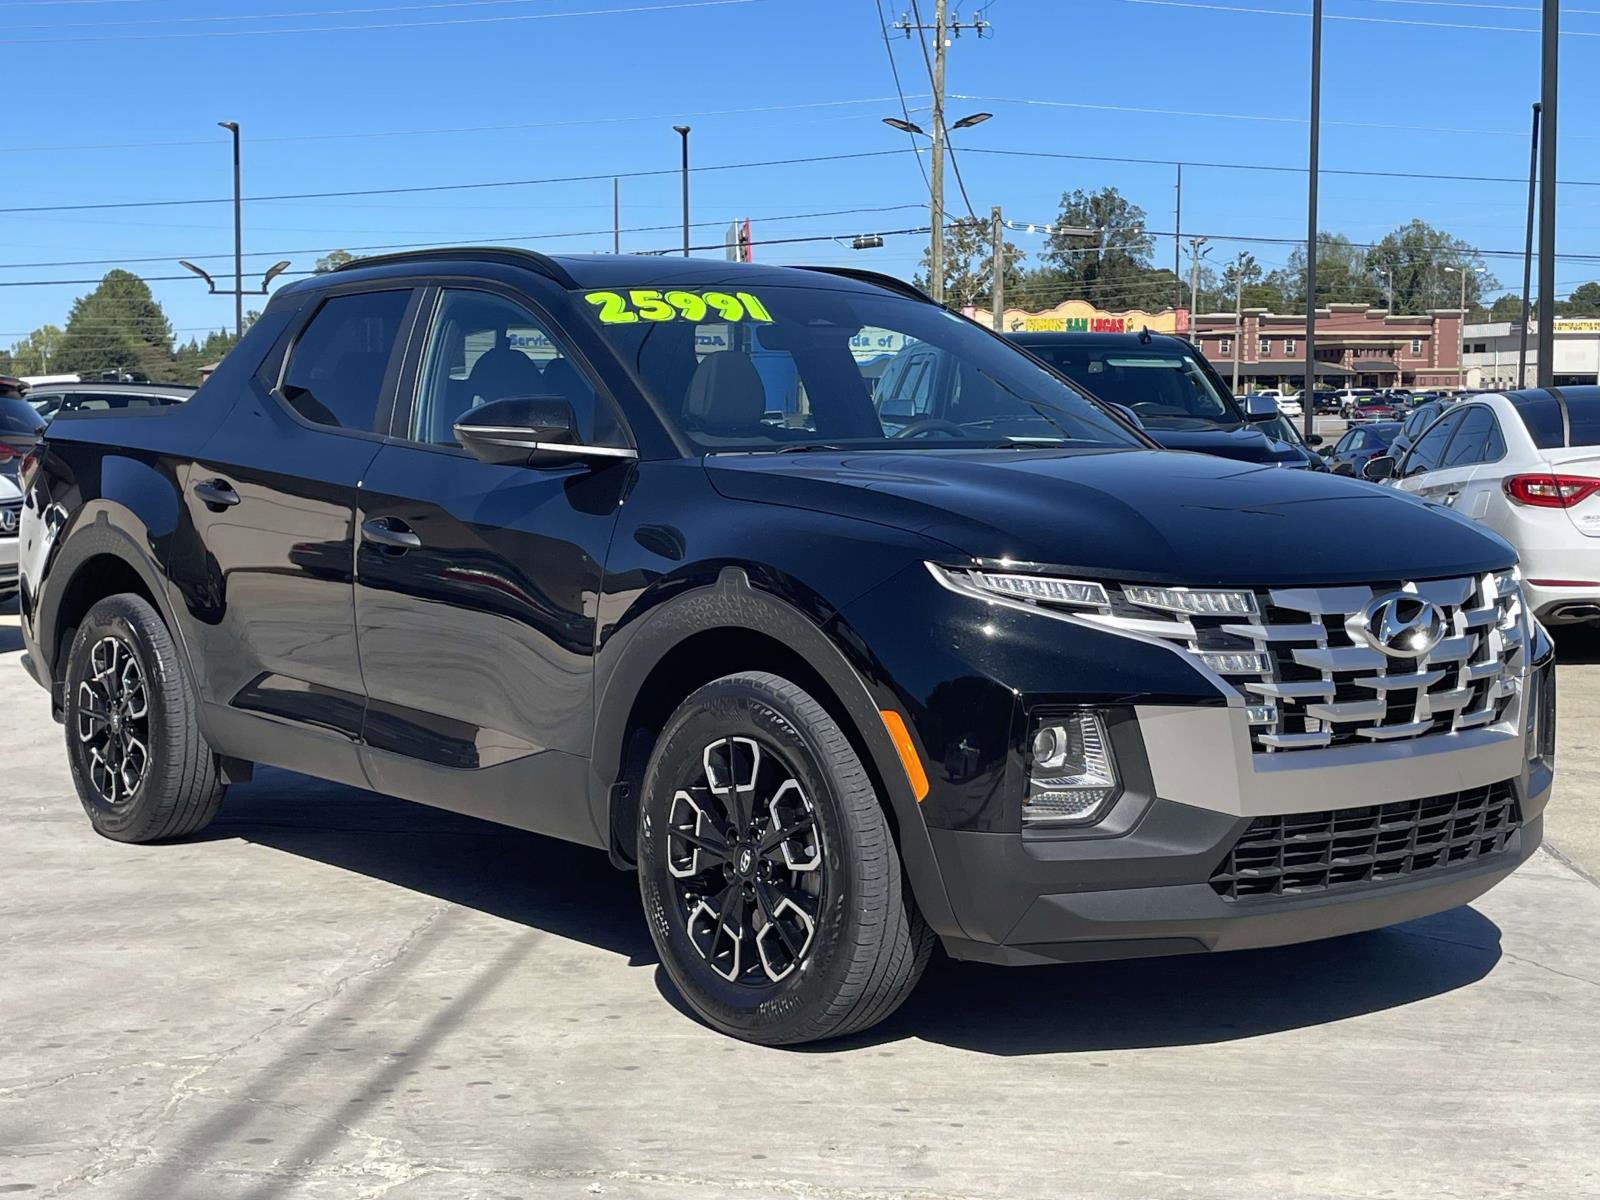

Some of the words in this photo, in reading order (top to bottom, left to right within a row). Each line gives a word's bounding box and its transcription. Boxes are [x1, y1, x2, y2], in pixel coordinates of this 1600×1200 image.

[584, 290, 775, 324] 25991
[1066, 318, 1088, 332] SAN
[851, 334, 870, 347] da
[877, 334, 894, 348] of
